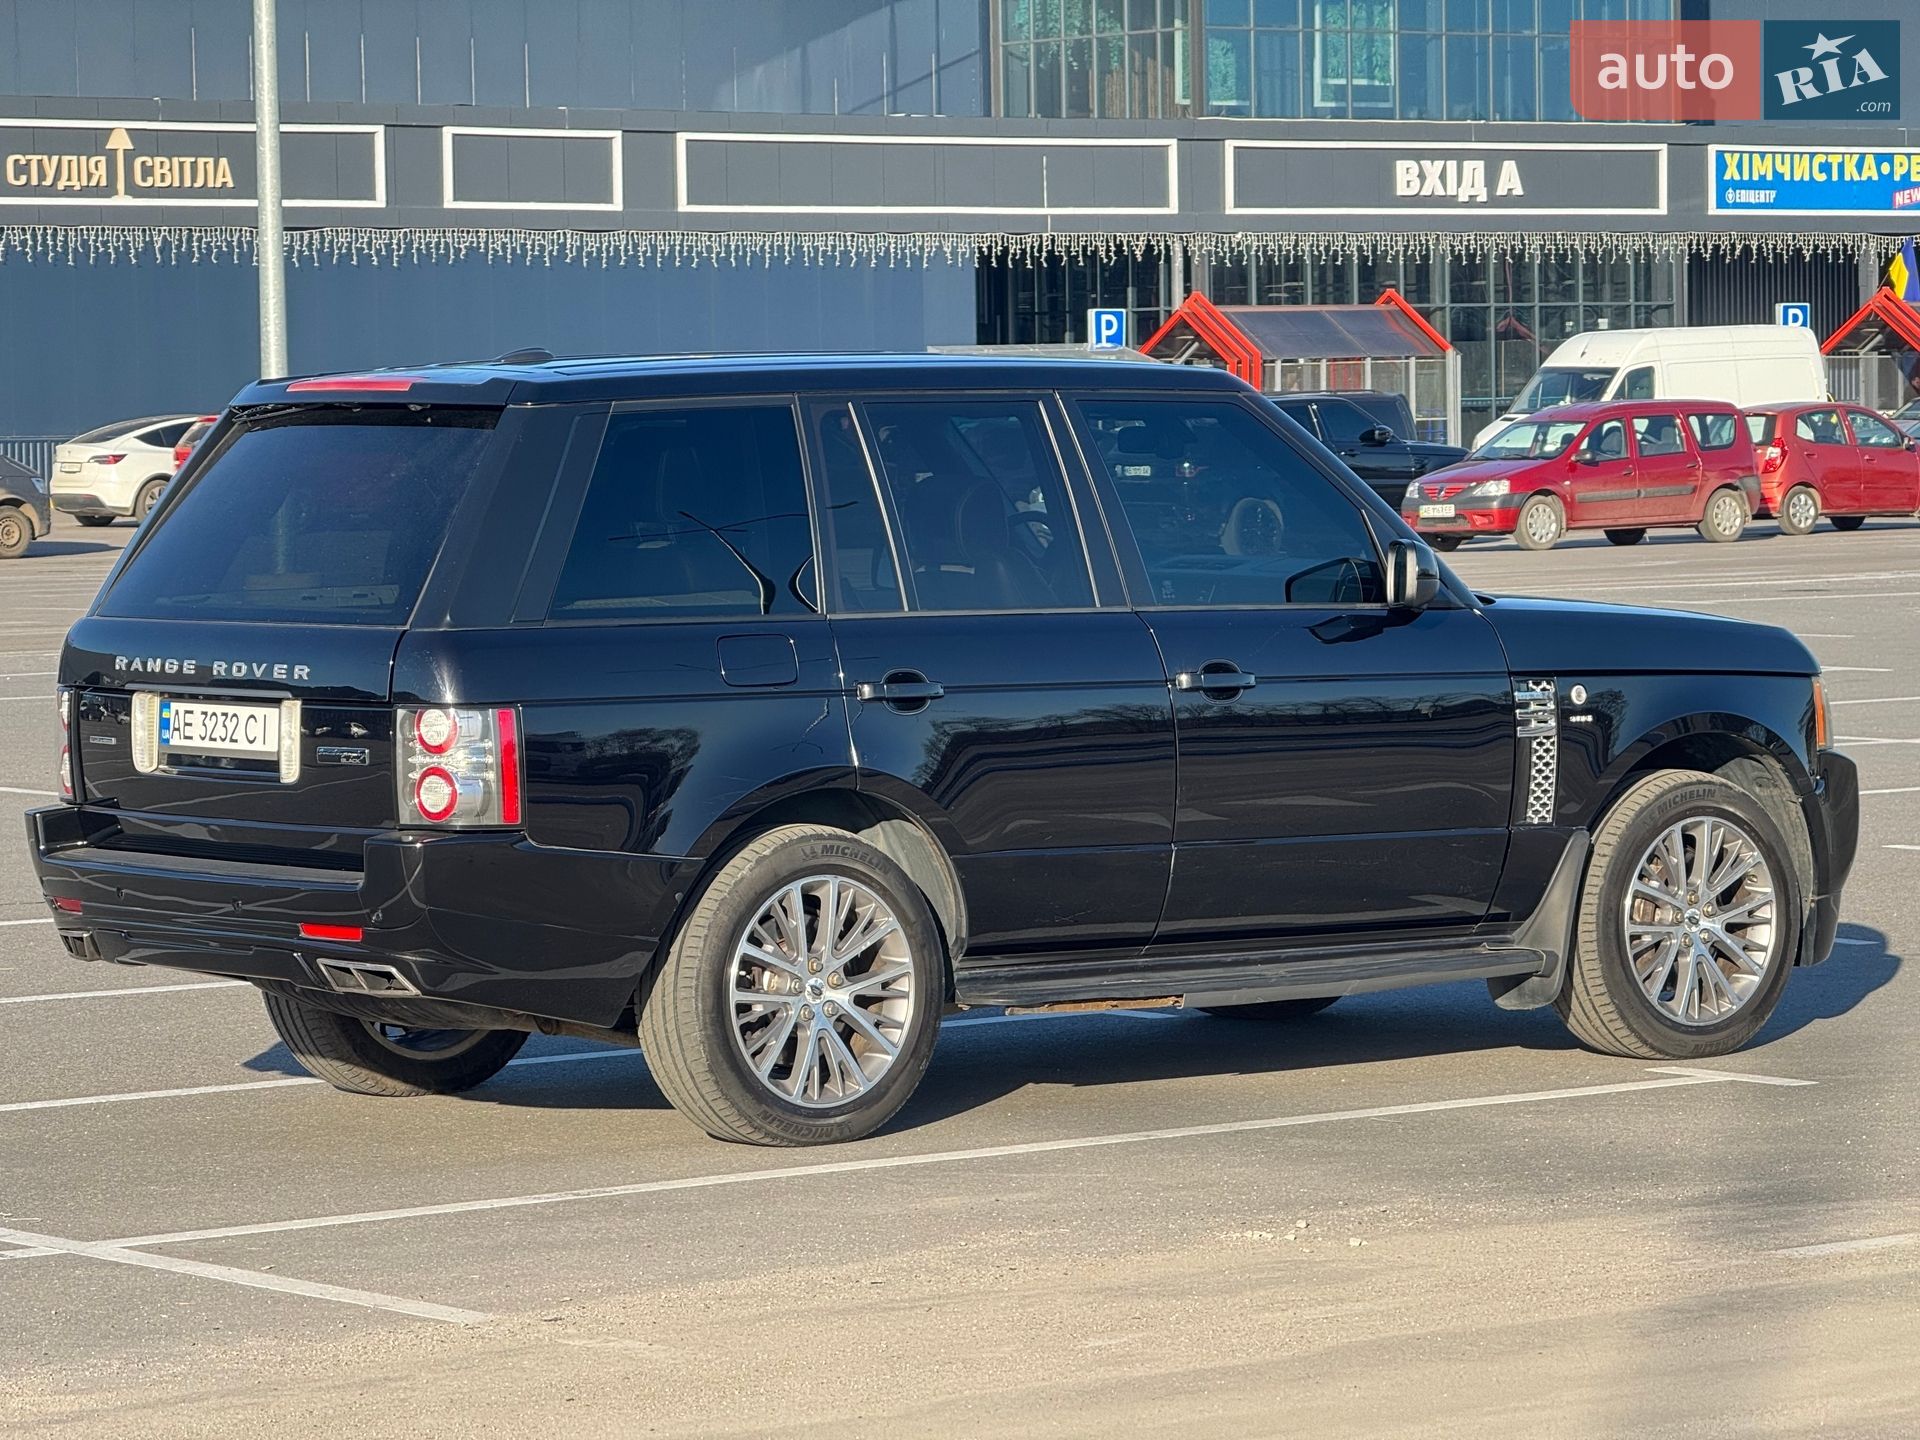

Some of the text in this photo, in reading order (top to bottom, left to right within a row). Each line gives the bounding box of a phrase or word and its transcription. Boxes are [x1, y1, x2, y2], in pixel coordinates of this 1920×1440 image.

[6, 154, 235, 191] СТУДІЯ СВІТЛА
[1396, 160, 1488, 203] ВХІД
[1735, 189, 1777, 204] ЕПІЦЕНТР
[1101, 314, 1118, 345] P
[114, 655, 311, 681] RANGE ROVER
[171, 709, 194, 740] AE
[199, 710, 240, 743] 3232
[1657, 788, 1717, 815] MICHELIN
[821, 844, 891, 874] MICHELIN
